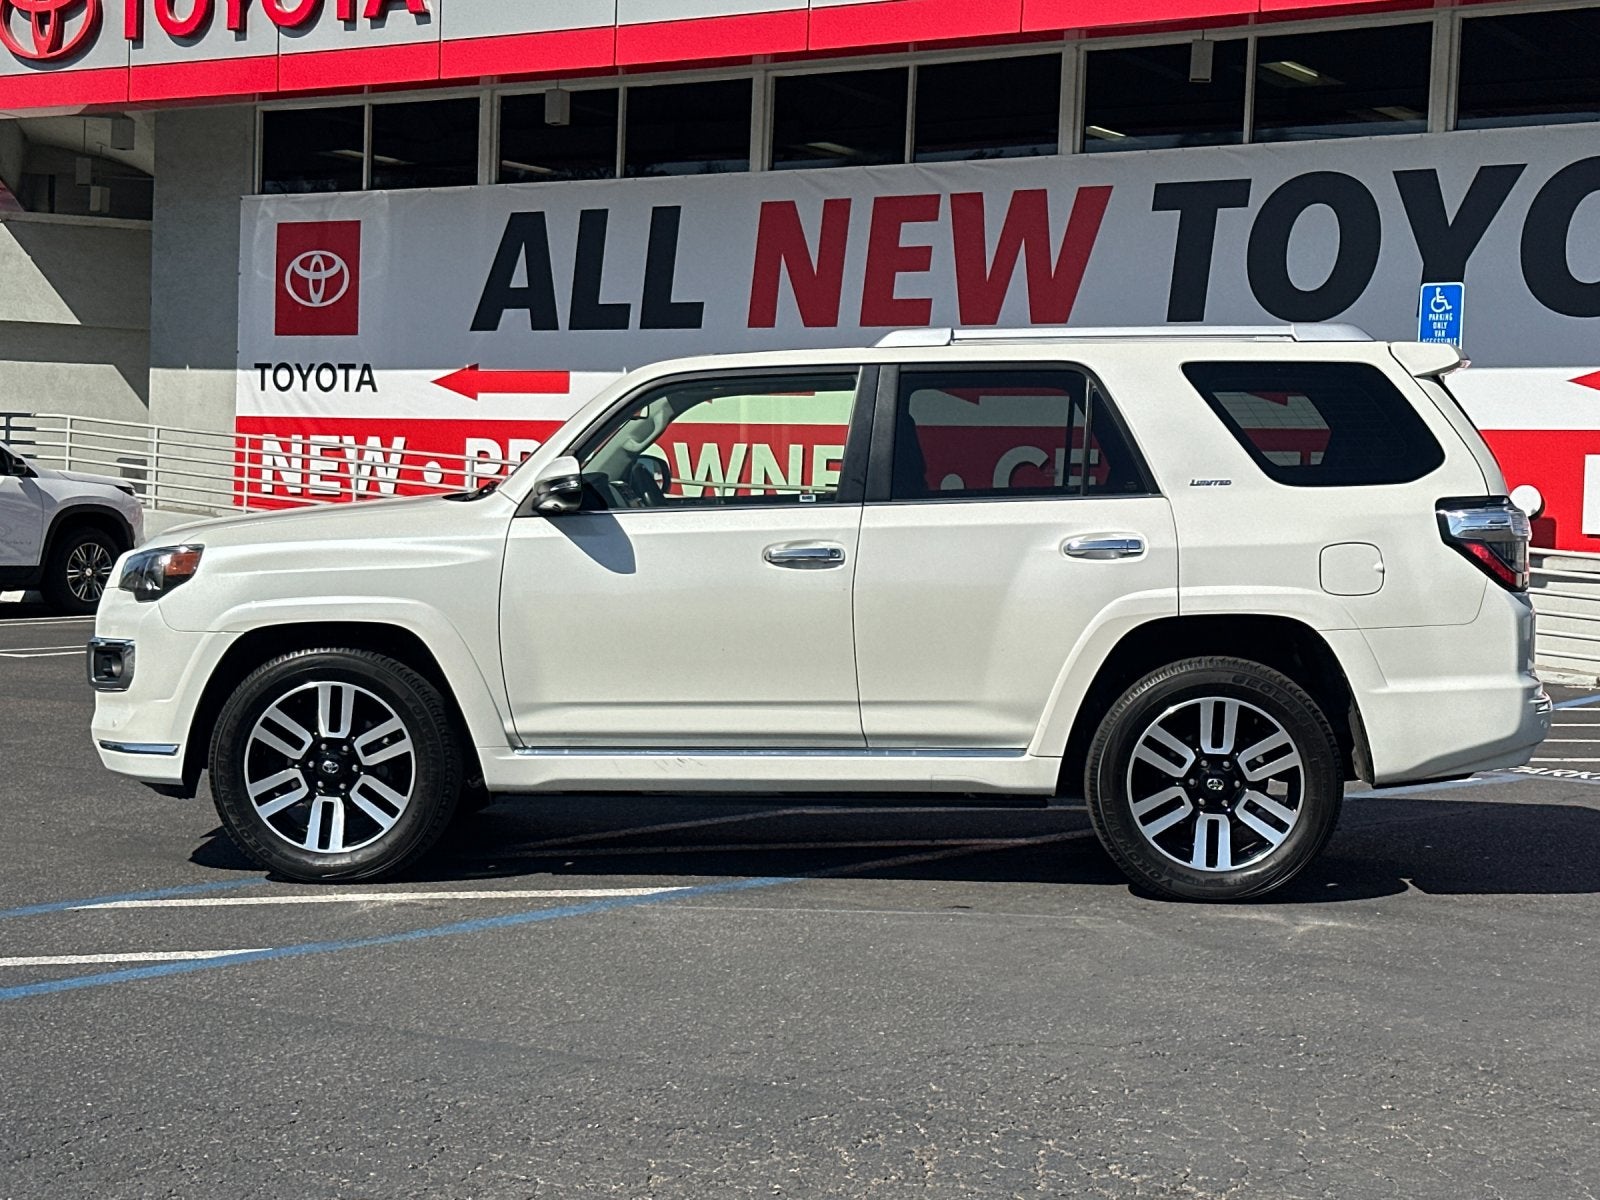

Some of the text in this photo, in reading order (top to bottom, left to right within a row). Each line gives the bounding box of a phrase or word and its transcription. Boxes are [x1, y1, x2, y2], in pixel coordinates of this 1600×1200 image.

[470, 205, 704, 331] ALL
[747, 185, 1114, 328] NEW
[1429, 313, 1453, 321] PARKING
[1432, 321, 1448, 330] ONLY
[254, 362, 378, 392] TOYOTA
[261, 433, 406, 495] NEW
